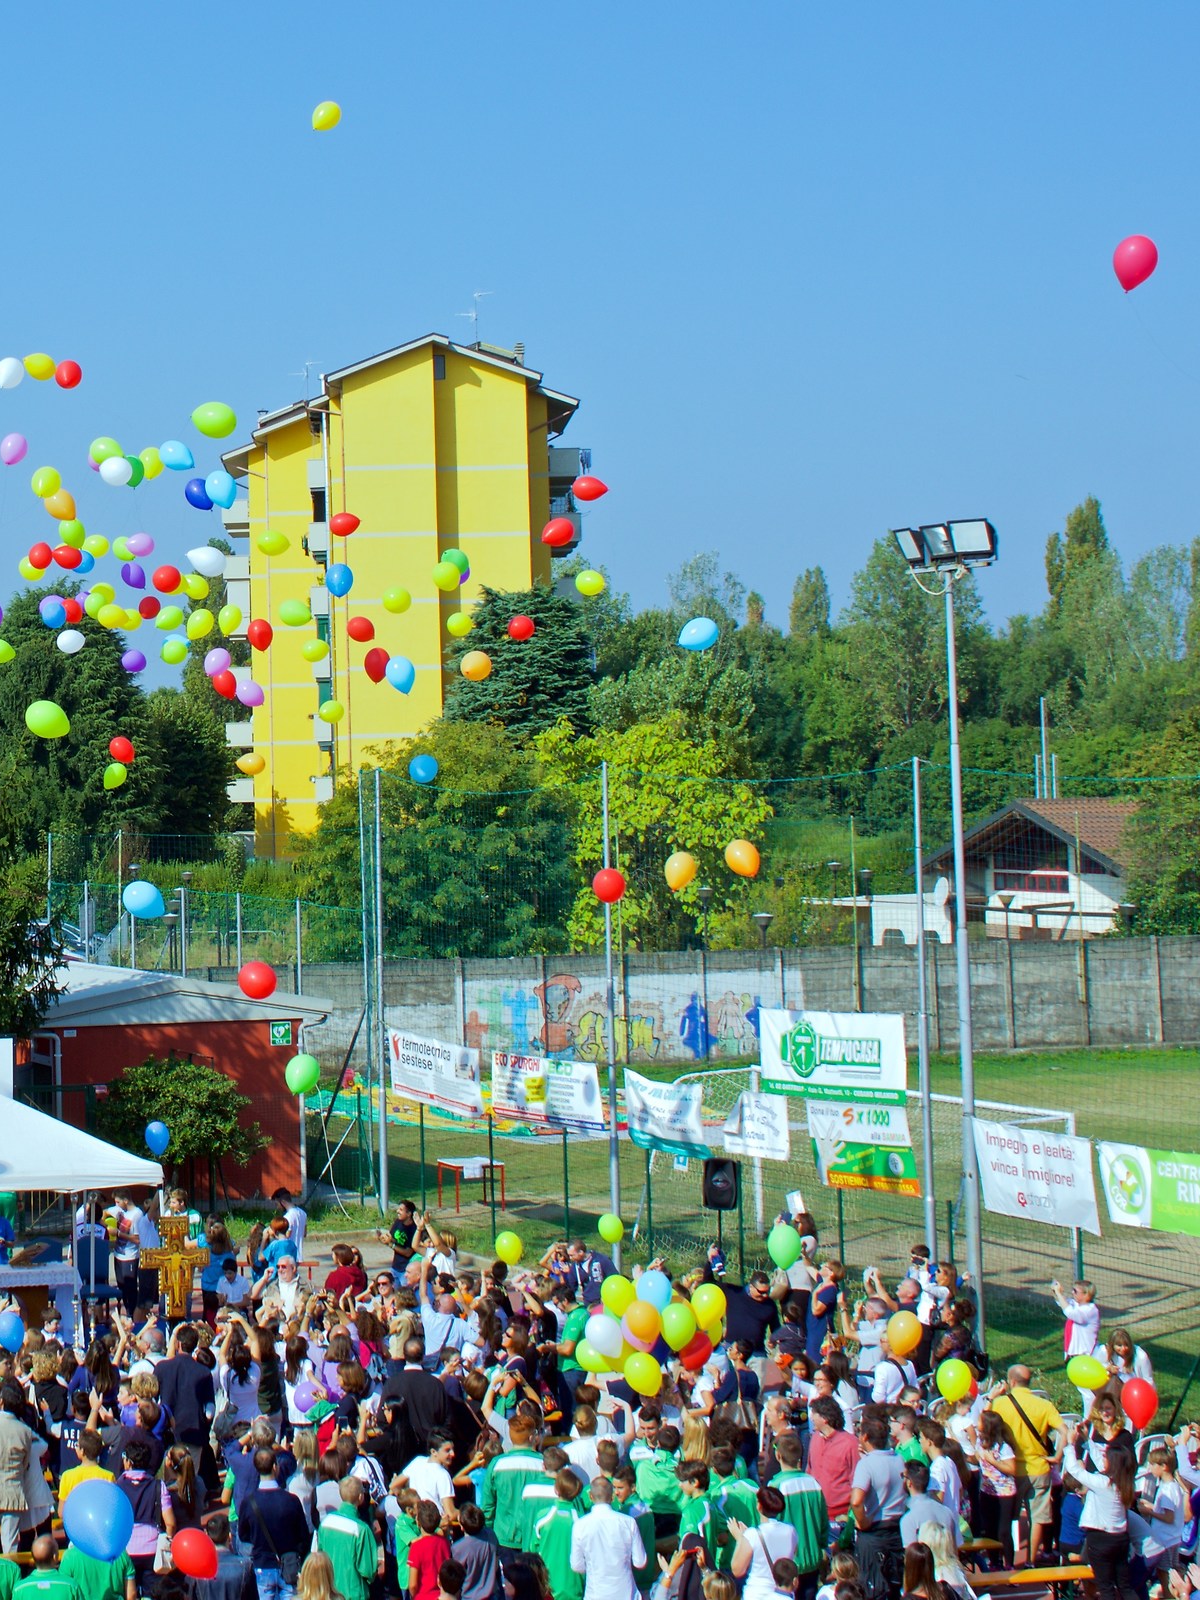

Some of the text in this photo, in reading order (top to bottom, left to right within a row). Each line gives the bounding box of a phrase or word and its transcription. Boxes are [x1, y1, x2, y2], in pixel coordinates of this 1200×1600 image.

[402, 1037, 452, 1061] termotecnica
[820, 1039, 879, 1063] TEMPOCASA
[401, 1053, 433, 1071] sestese
[494, 1053, 540, 1072] ECO SPURGHI
[547, 1060, 573, 1076] ECO
[842, 1107, 855, 1126] 5
[866, 1109, 891, 1127] 1000
[1032, 1143, 1041, 1155] e
[991, 1158, 1019, 1176] vinca
[828, 1172, 868, 1187] SOSTIENICI
